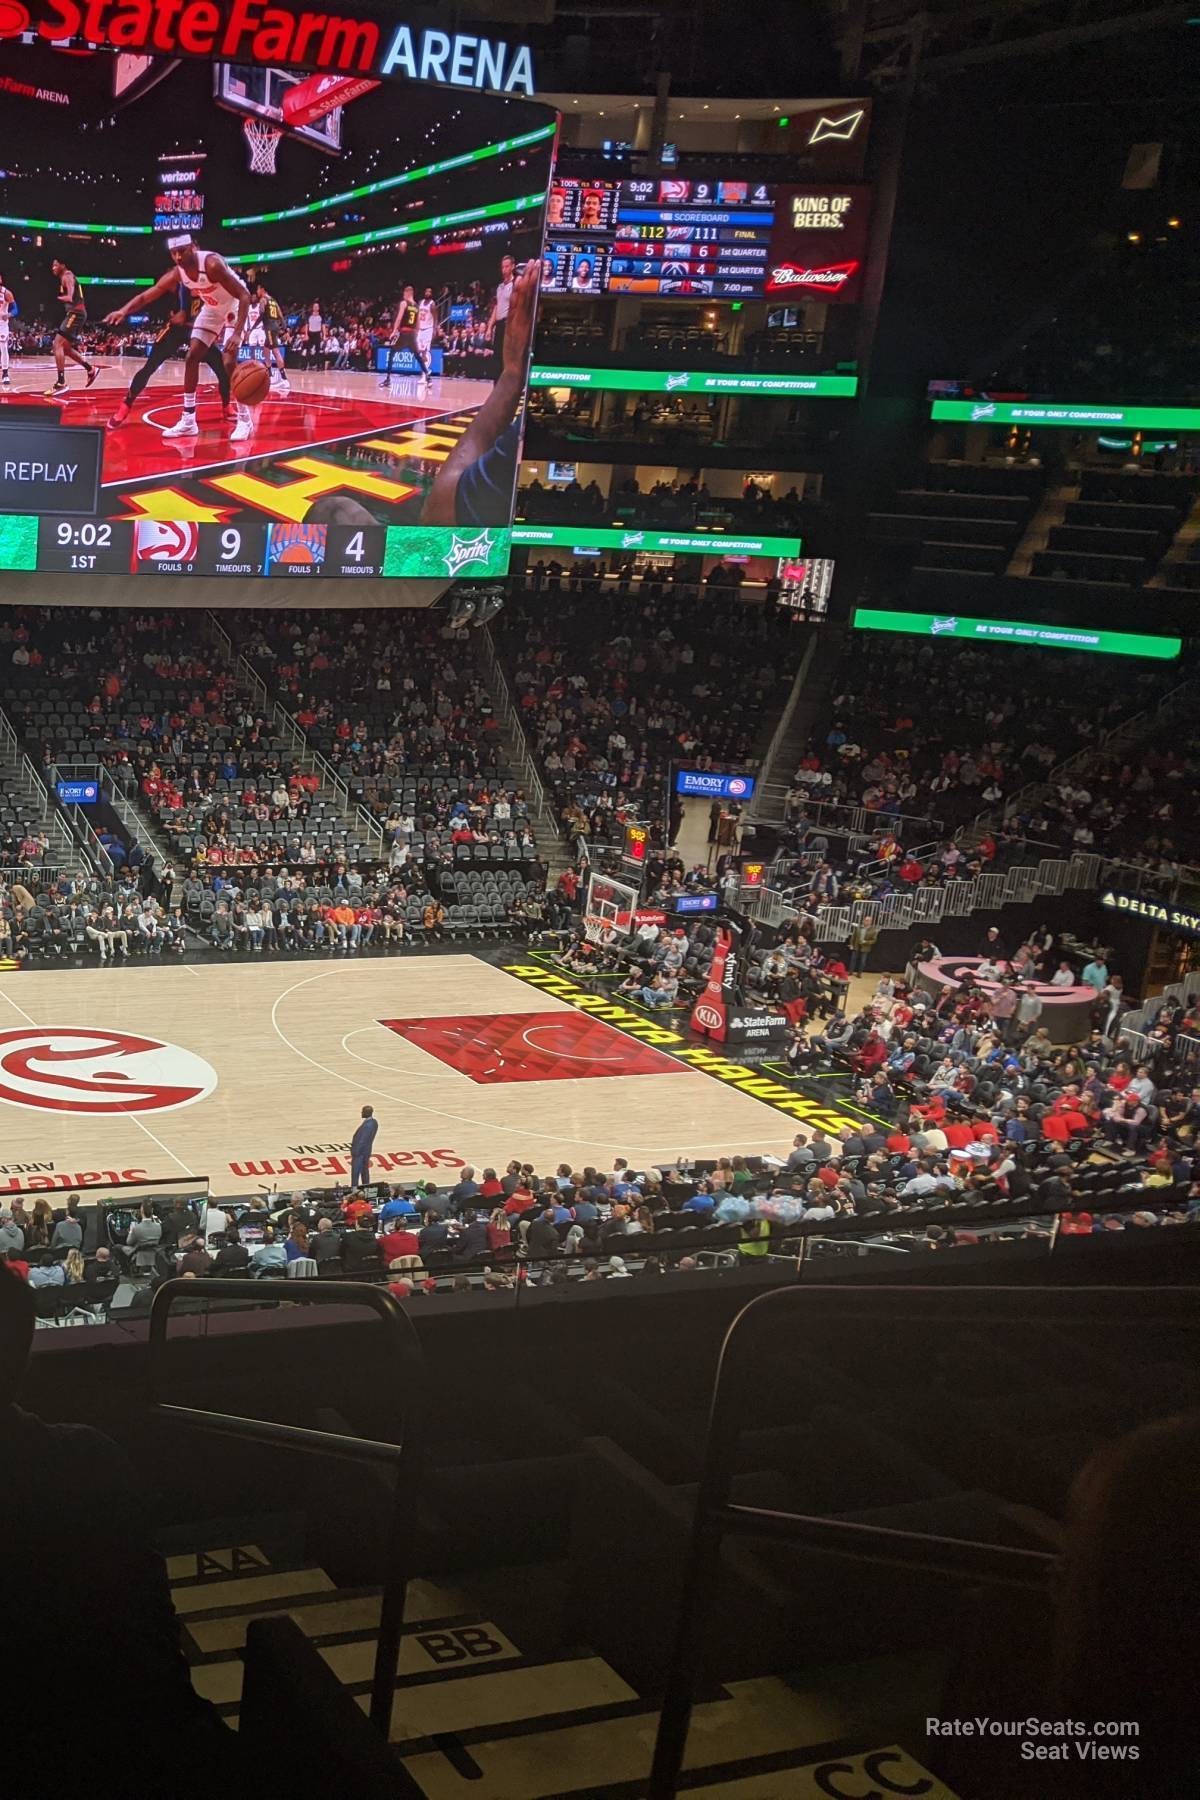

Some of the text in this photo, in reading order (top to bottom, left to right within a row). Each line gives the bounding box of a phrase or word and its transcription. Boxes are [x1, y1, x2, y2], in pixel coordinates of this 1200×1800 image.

[38, 0, 535, 96] StateFarm ARENA
[36, 88, 70, 105] ARENA
[161, 171, 196, 183] verizon
[630, 183, 766, 199] 9:02 9 4
[793, 197, 851, 212] KING OF
[674, 214, 729, 222] SCOREBOARD
[793, 213, 844, 228] BEERS.
[641, 227, 756, 240] 112 111 FINAL
[646, 245, 654, 256] 5
[699, 246, 708, 257] 6
[732, 248, 766, 257] QUARTER
[643, 263, 652, 274] 2
[697, 264, 706, 275] 4
[730, 266, 764, 275] QUARTER
[772, 269, 848, 283] Budweiser
[740, 380, 761, 388] ONLY
[762, 381, 816, 389] COMPETITION
[4, 462, 78, 482] REPLAY
[57, 523, 111, 547] 9:02
[221, 529, 241, 559] 9
[345, 531, 364, 561] 4
[452, 544, 488, 563] Sprite
[71, 555, 96, 569] 1ST
[158, 563, 193, 572] FOULS 0
[215, 564, 262, 573] TIMEOUTS 7
[288, 565, 320, 573] FOULS 1
[341, 566, 383, 574] TIMEOUTS 7
[988, 626, 1014, 635] YOUR
[1015, 628, 1038, 637] ONLY
[1040, 629, 1099, 644] COMPETITION
[685, 776, 724, 788] EMORY
[1118, 896, 1168, 921] DELTA
[722, 953, 736, 990] xfinity
[700, 1009, 718, 1026] KIA
[743, 1016, 786, 1028] StateFarm
[746, 1029, 770, 1037] ARENA
[503, 965, 864, 1135] ATLANTA HAWKS
[288, 1142, 353, 1155] RENA
[228, 1149, 466, 1177] StatFarm
[198, 1548, 271, 1574] AA
[416, 1628, 503, 1663] BB
[813, 1752, 934, 1800] CC
